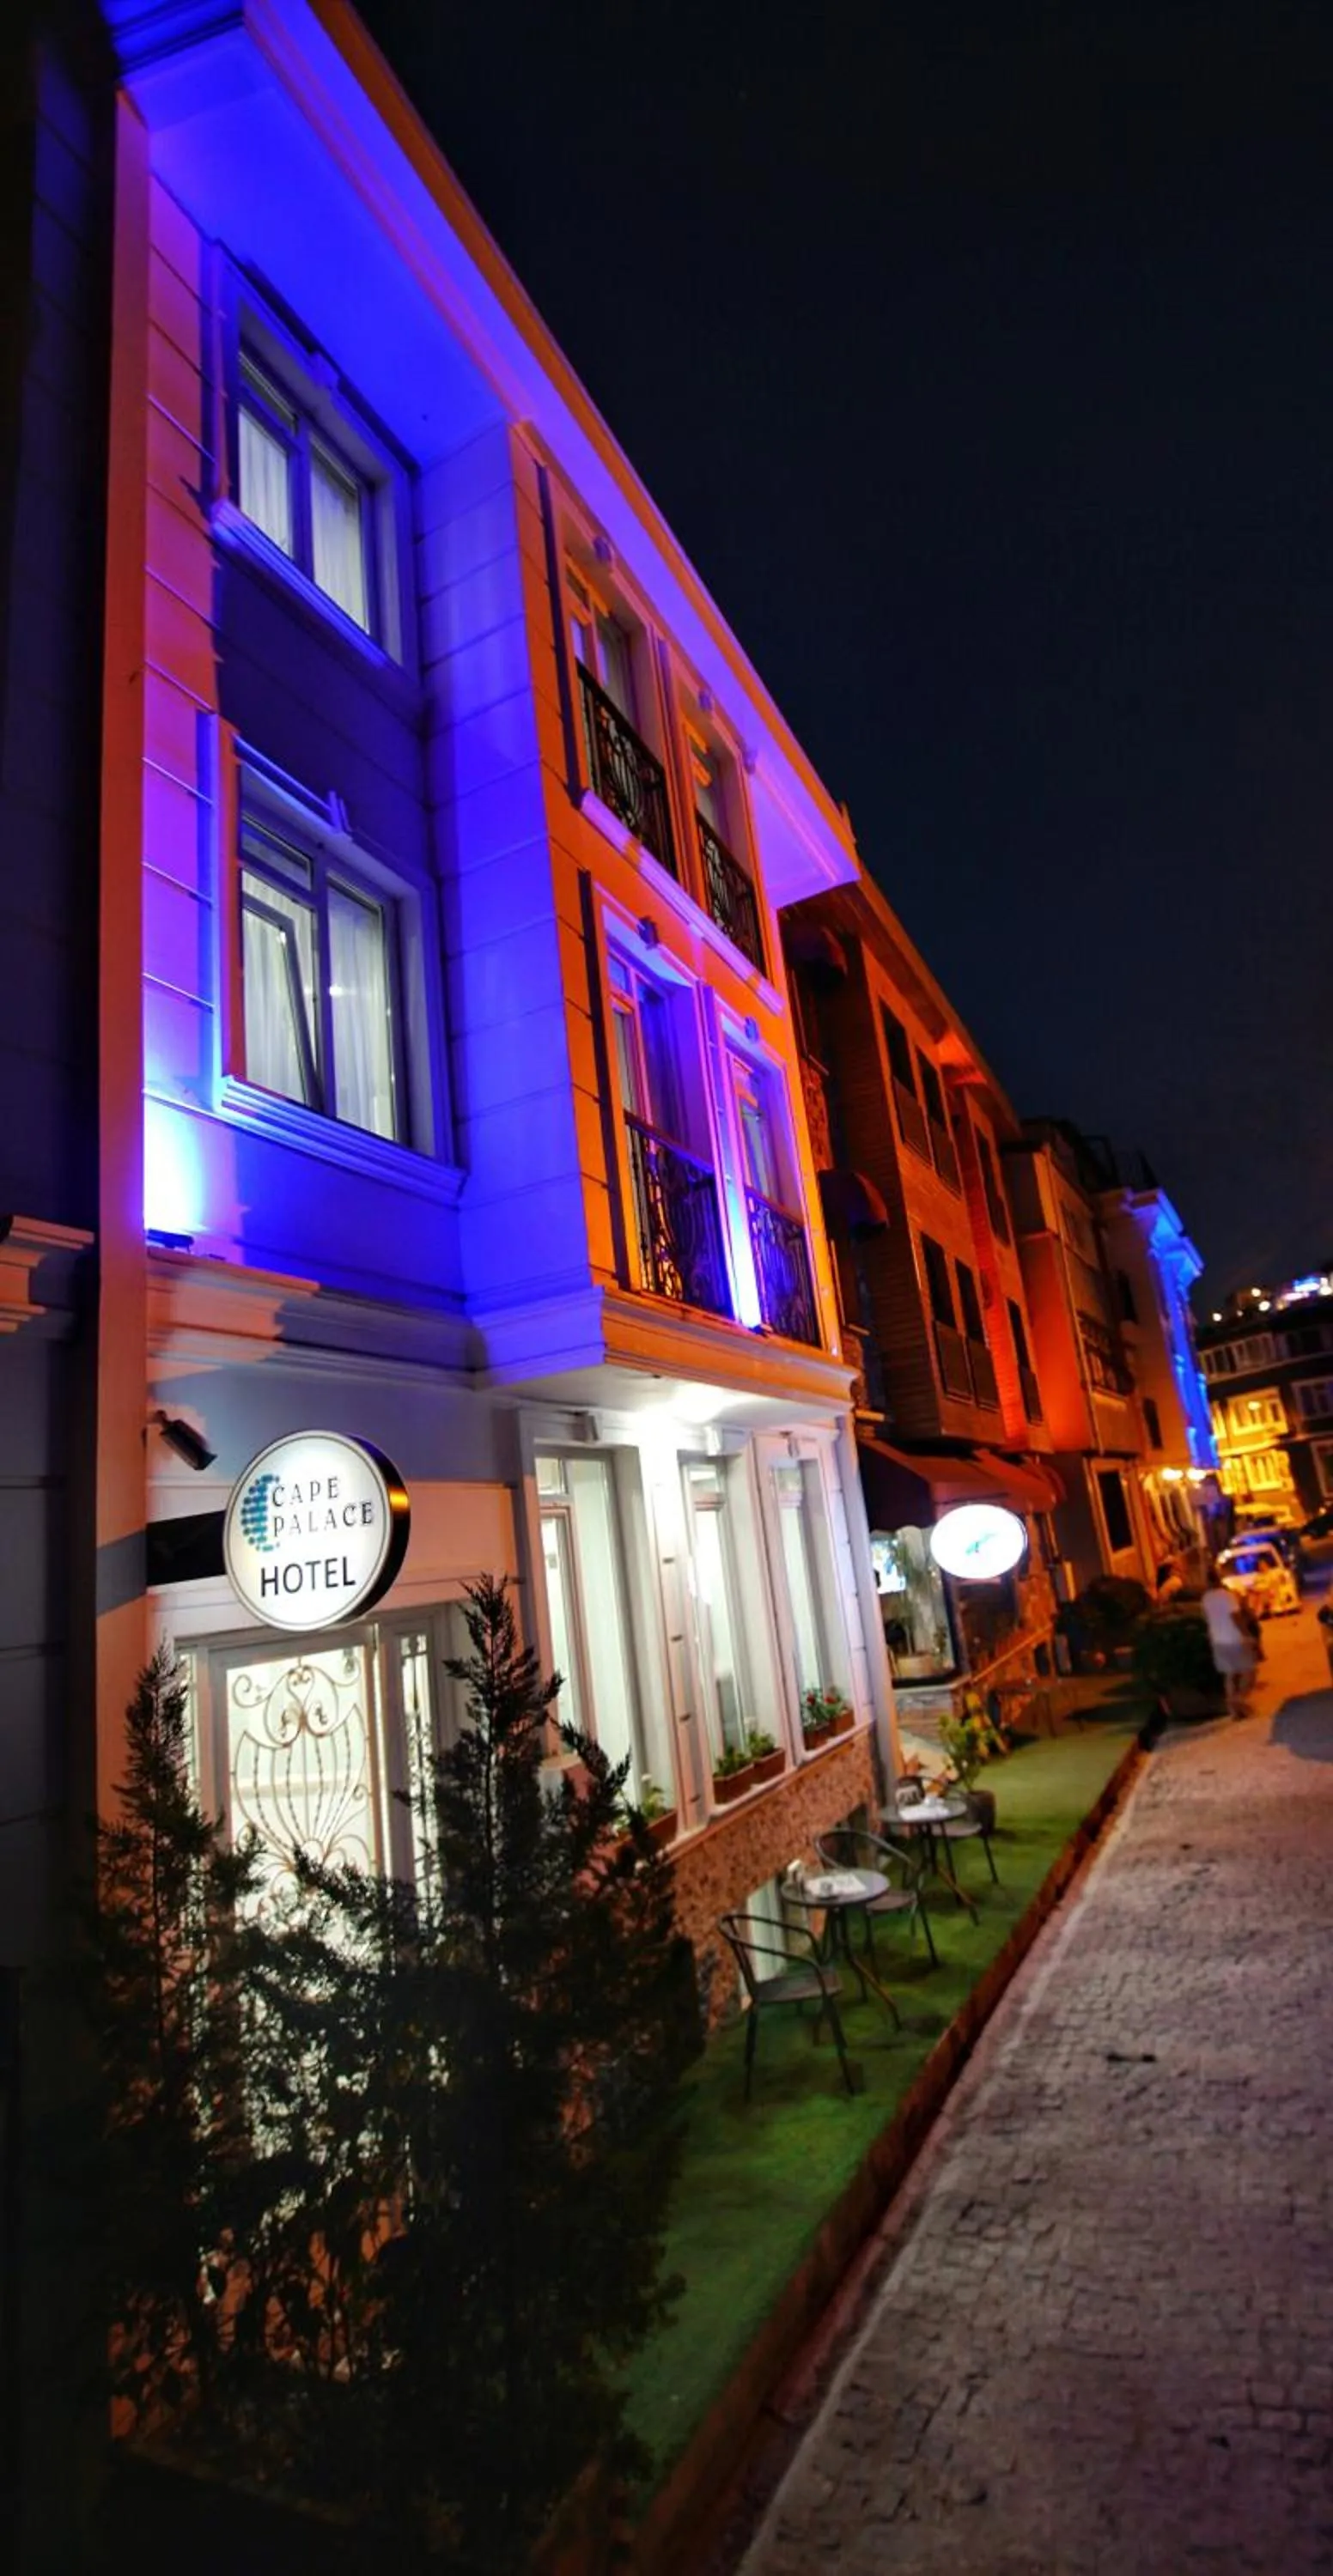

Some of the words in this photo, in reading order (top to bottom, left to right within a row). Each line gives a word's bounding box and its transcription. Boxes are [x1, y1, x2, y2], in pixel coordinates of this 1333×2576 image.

[271, 1476, 339, 1507] CAPE
[273, 1501, 374, 1537] PALACE
[260, 1557, 356, 1597] HOTEL
